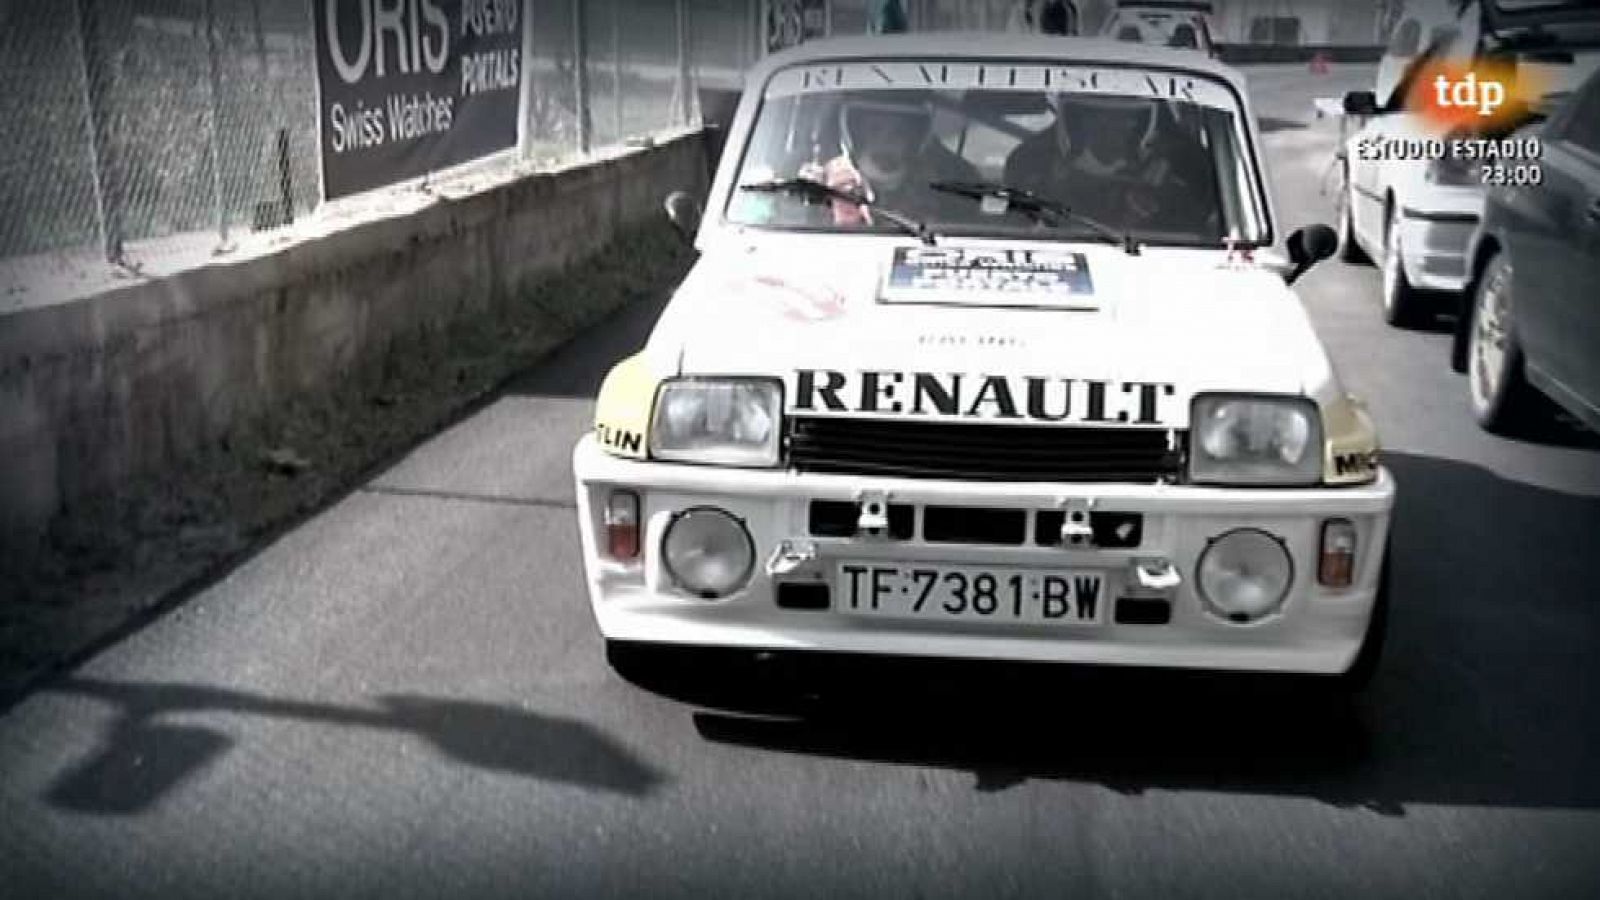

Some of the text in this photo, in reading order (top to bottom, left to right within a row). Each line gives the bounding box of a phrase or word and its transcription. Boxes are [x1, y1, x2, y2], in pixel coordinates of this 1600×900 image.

[327, 0, 449, 83] ORIS
[461, 47, 518, 96] PORTALS
[331, 92, 454, 152] Swiss Watches
[794, 368, 1177, 424] RENAULT
